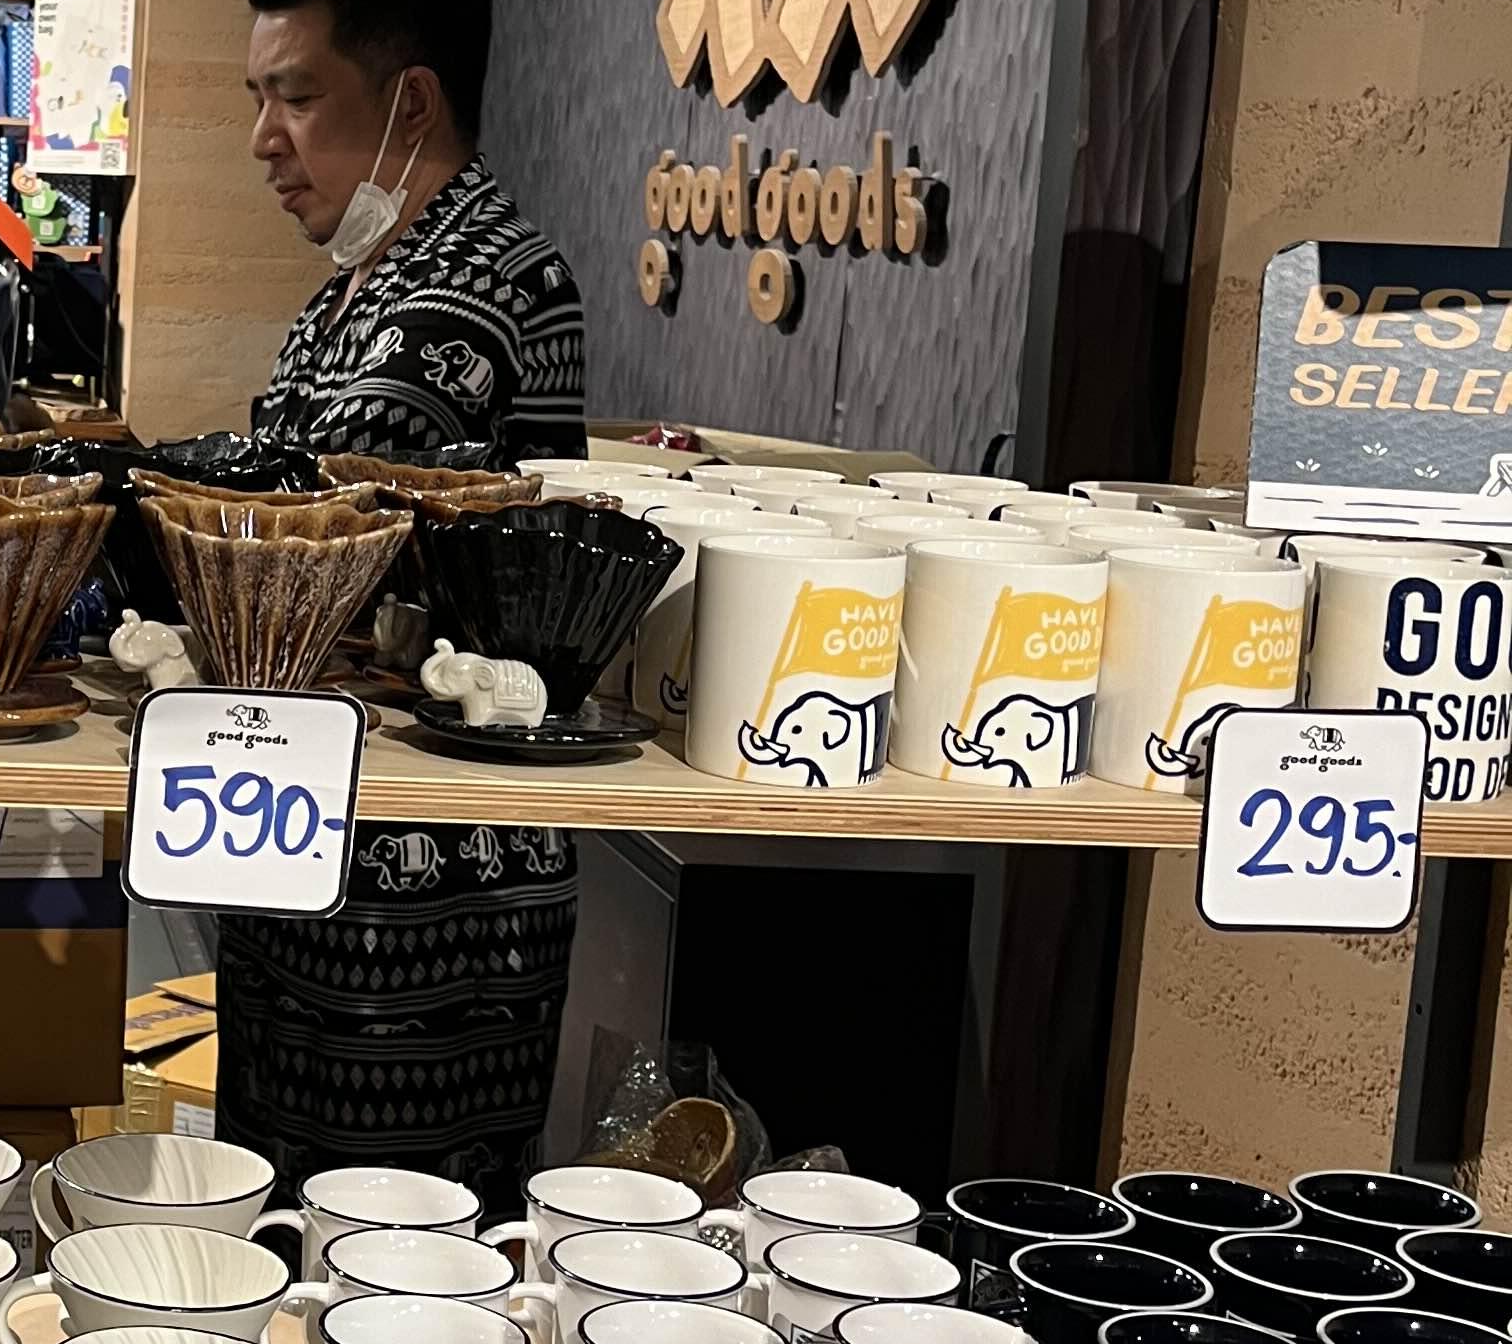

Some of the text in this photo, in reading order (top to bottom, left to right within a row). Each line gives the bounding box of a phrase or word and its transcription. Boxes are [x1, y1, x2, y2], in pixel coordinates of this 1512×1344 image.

[639, 130, 928, 325] good goods
[206, 730, 288, 749] good goods
[1280, 755, 1362, 772] good goods
